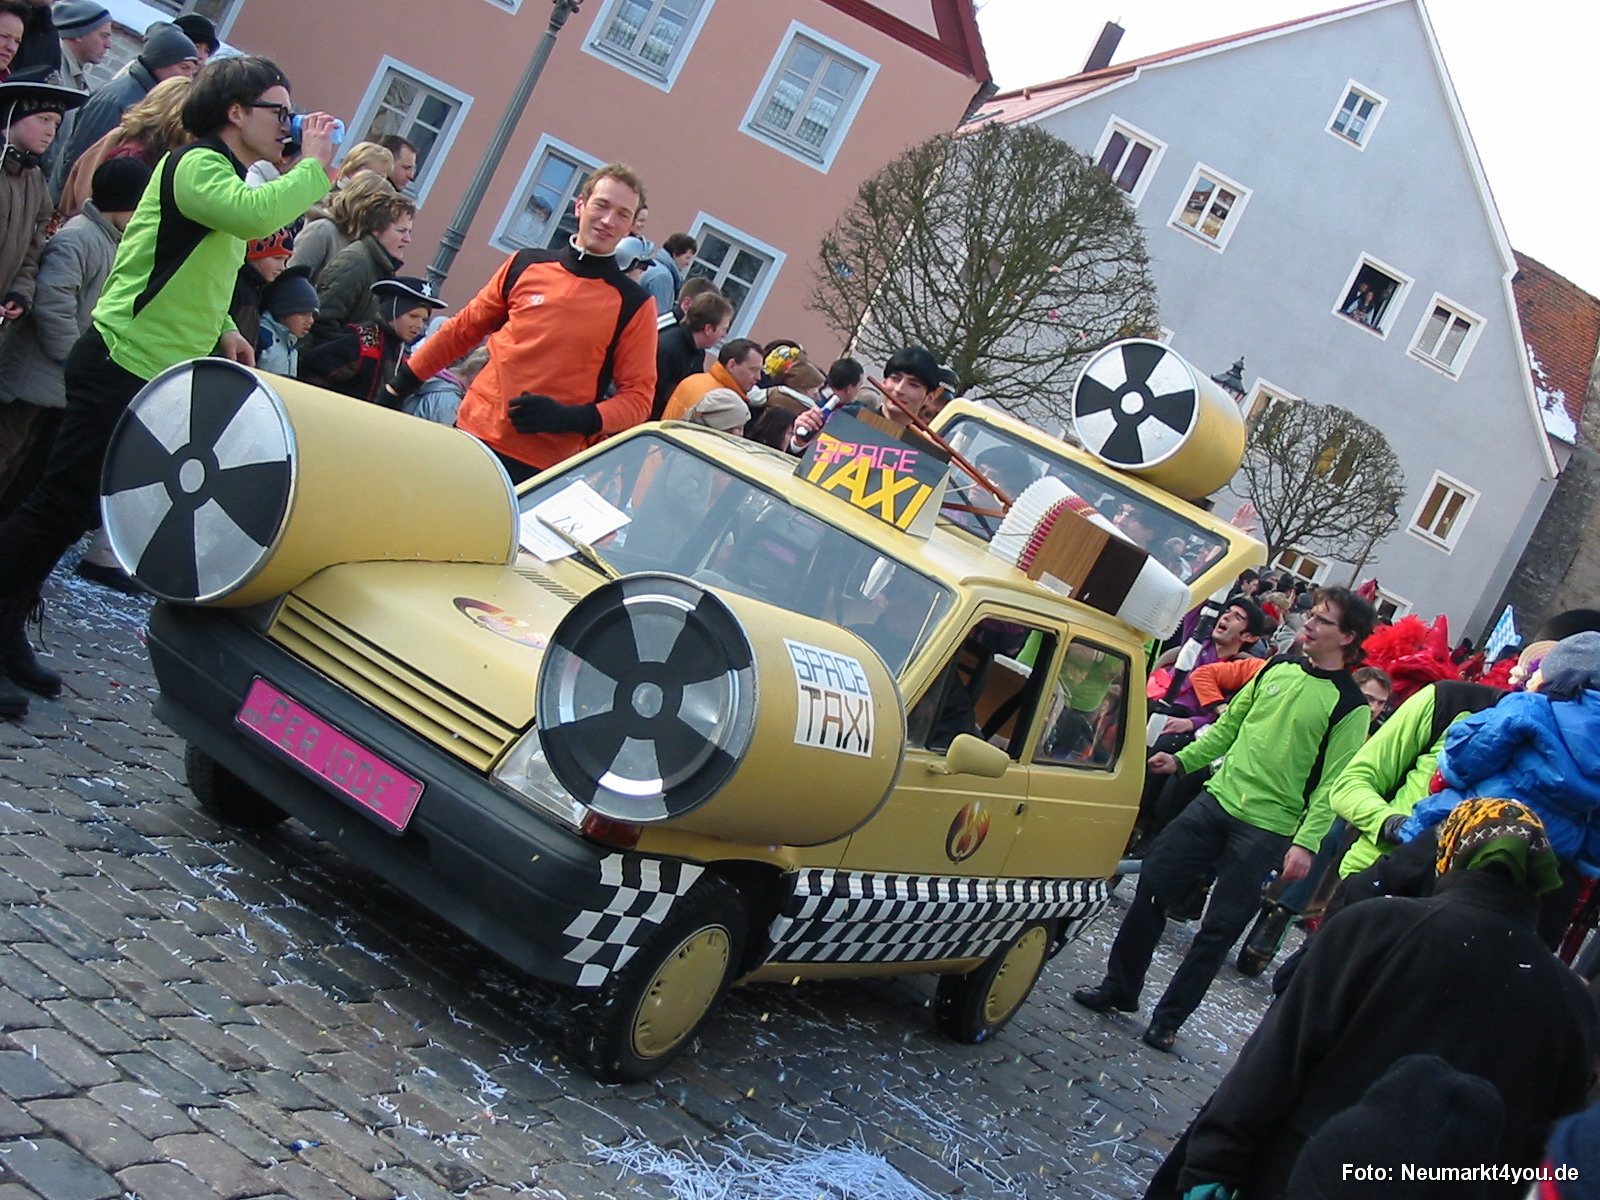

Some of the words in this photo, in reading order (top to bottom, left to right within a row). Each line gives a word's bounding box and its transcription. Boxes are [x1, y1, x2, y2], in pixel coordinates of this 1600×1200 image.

[806, 432, 934, 530] TAXI
[812, 439, 919, 473] SPACE
[788, 643, 868, 696] SPACE
[800, 683, 871, 754] TAXI
